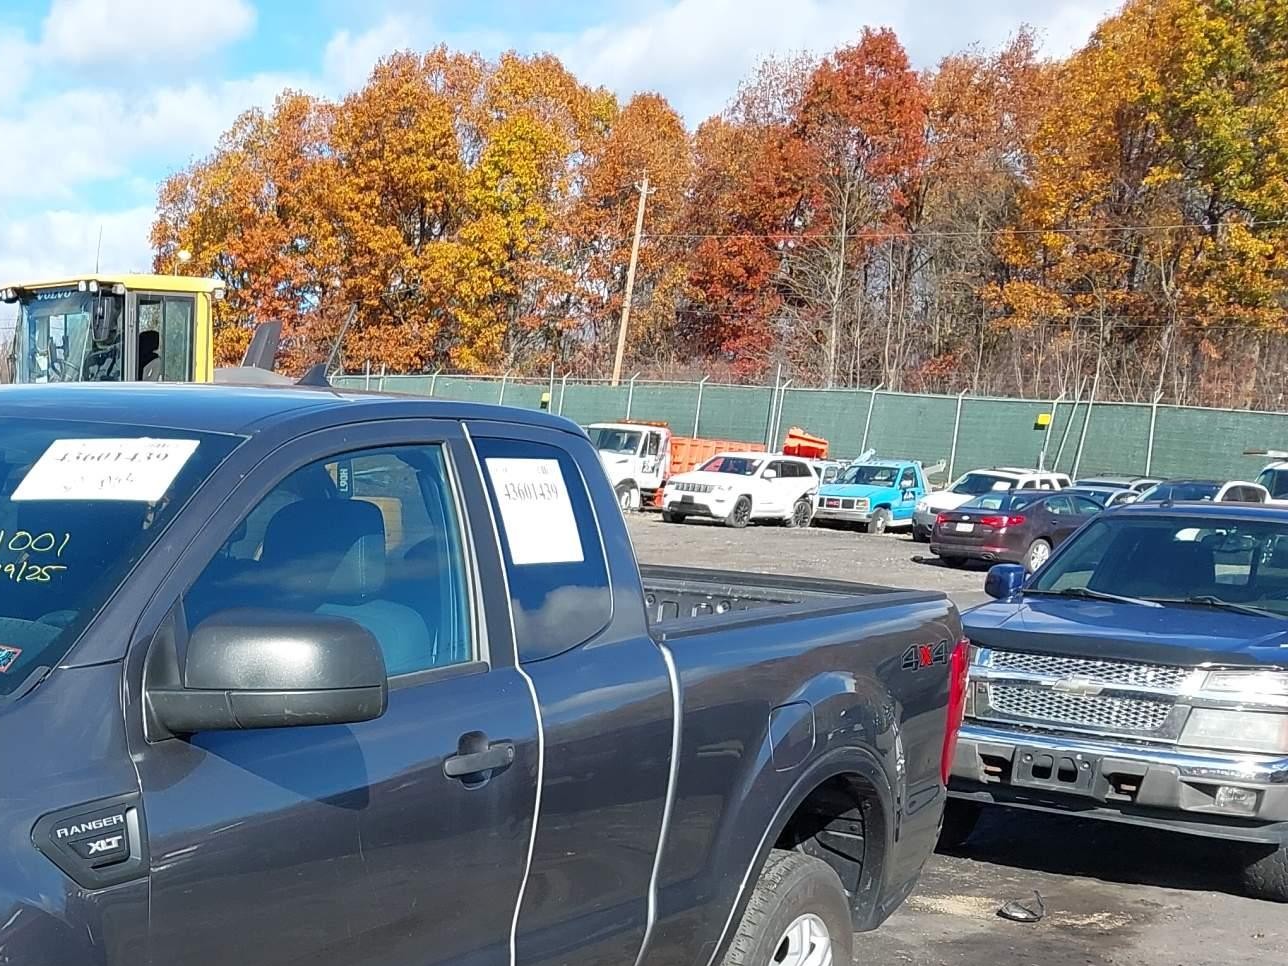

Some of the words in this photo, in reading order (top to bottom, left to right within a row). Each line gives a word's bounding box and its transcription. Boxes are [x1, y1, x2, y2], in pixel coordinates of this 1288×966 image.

[339, 468, 349, 492] L90H
[56, 814, 125, 839] RANGER
[86, 835, 123, 855] XLT
